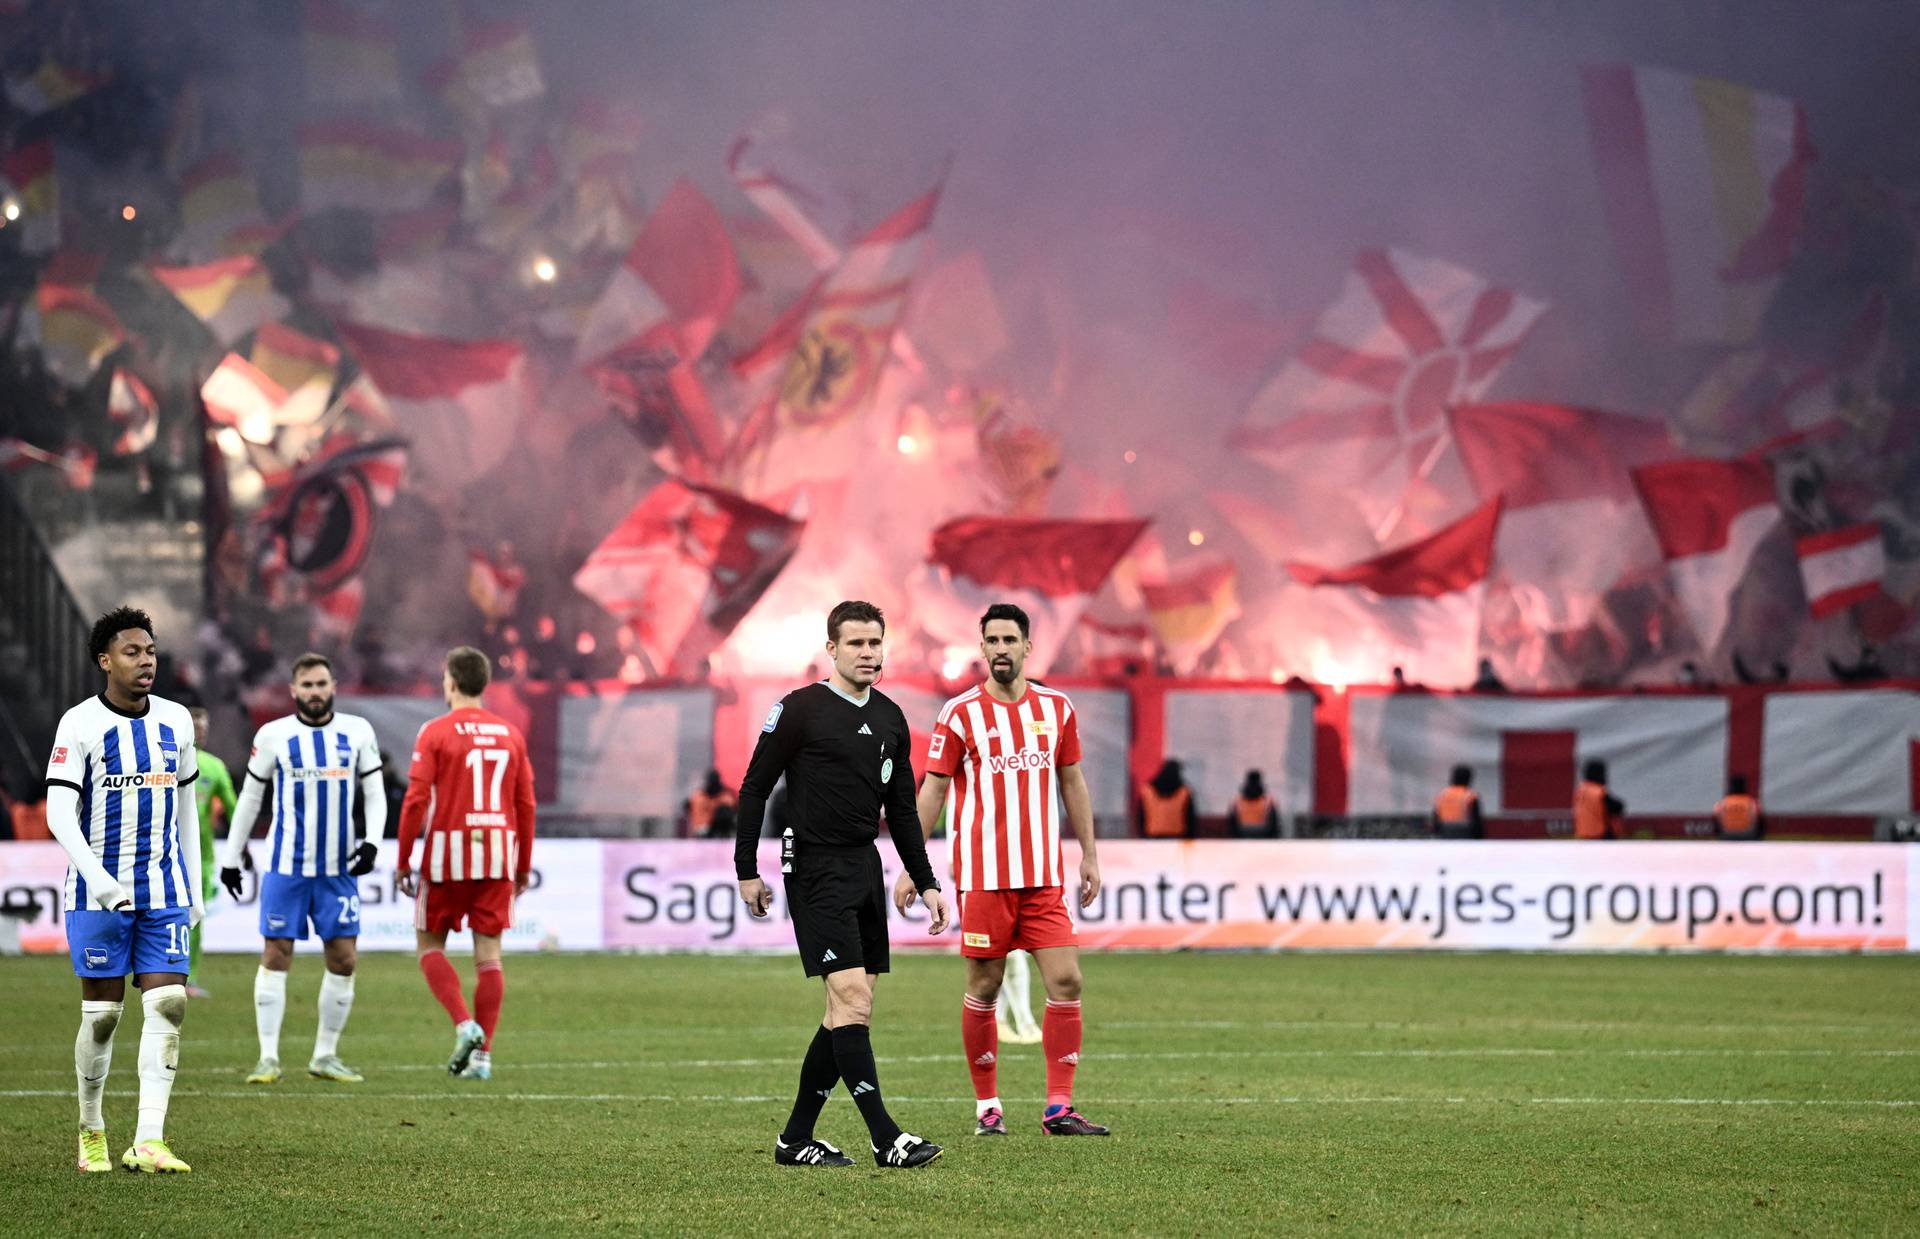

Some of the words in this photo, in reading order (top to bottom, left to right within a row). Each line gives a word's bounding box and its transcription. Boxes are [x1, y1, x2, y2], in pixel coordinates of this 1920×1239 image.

[989, 749, 1050, 771] wefox
[465, 748, 510, 811] 17
[337, 896, 360, 924] 29
[1077, 872, 1236, 922] unter
[1257, 868, 1885, 939] www.jes-group.com!
[165, 923, 189, 956] 10
